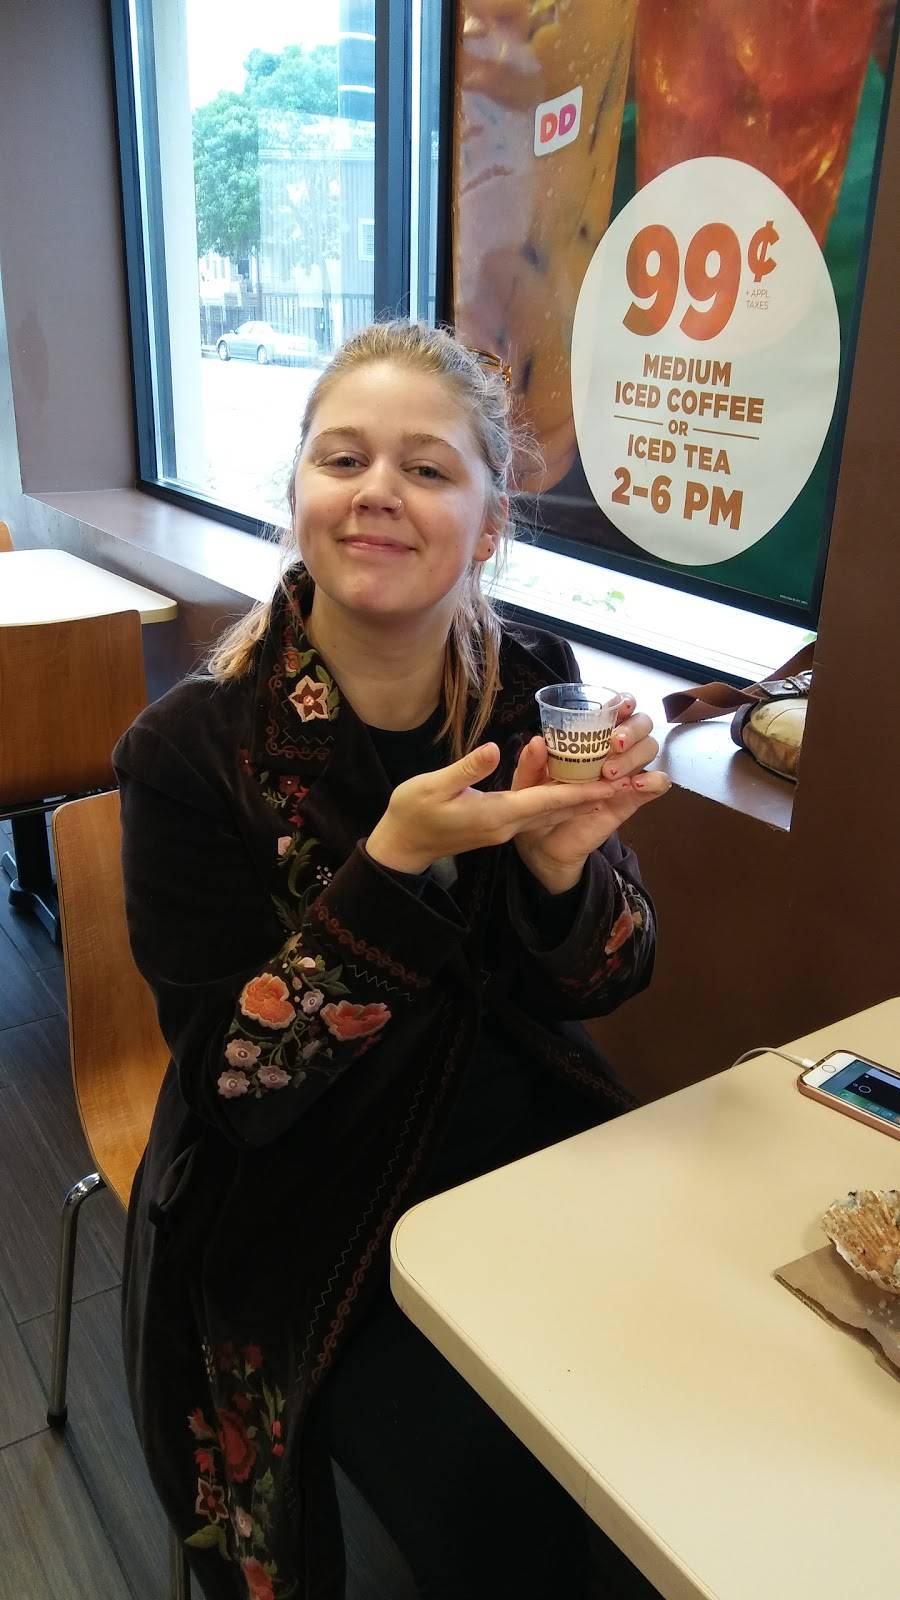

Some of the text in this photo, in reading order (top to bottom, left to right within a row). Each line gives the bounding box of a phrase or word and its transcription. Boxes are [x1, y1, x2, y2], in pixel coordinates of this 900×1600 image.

[540, 104, 577, 144] DD
[745, 299, 769, 310] TAXES
[643, 353, 732, 387] MEDIUM
[615, 381, 765, 424] ICED COFFEE
[668, 419, 689, 436] OR
[627, 434, 731, 475] ICED TEA
[611, 466, 743, 530] 2-6 PM
